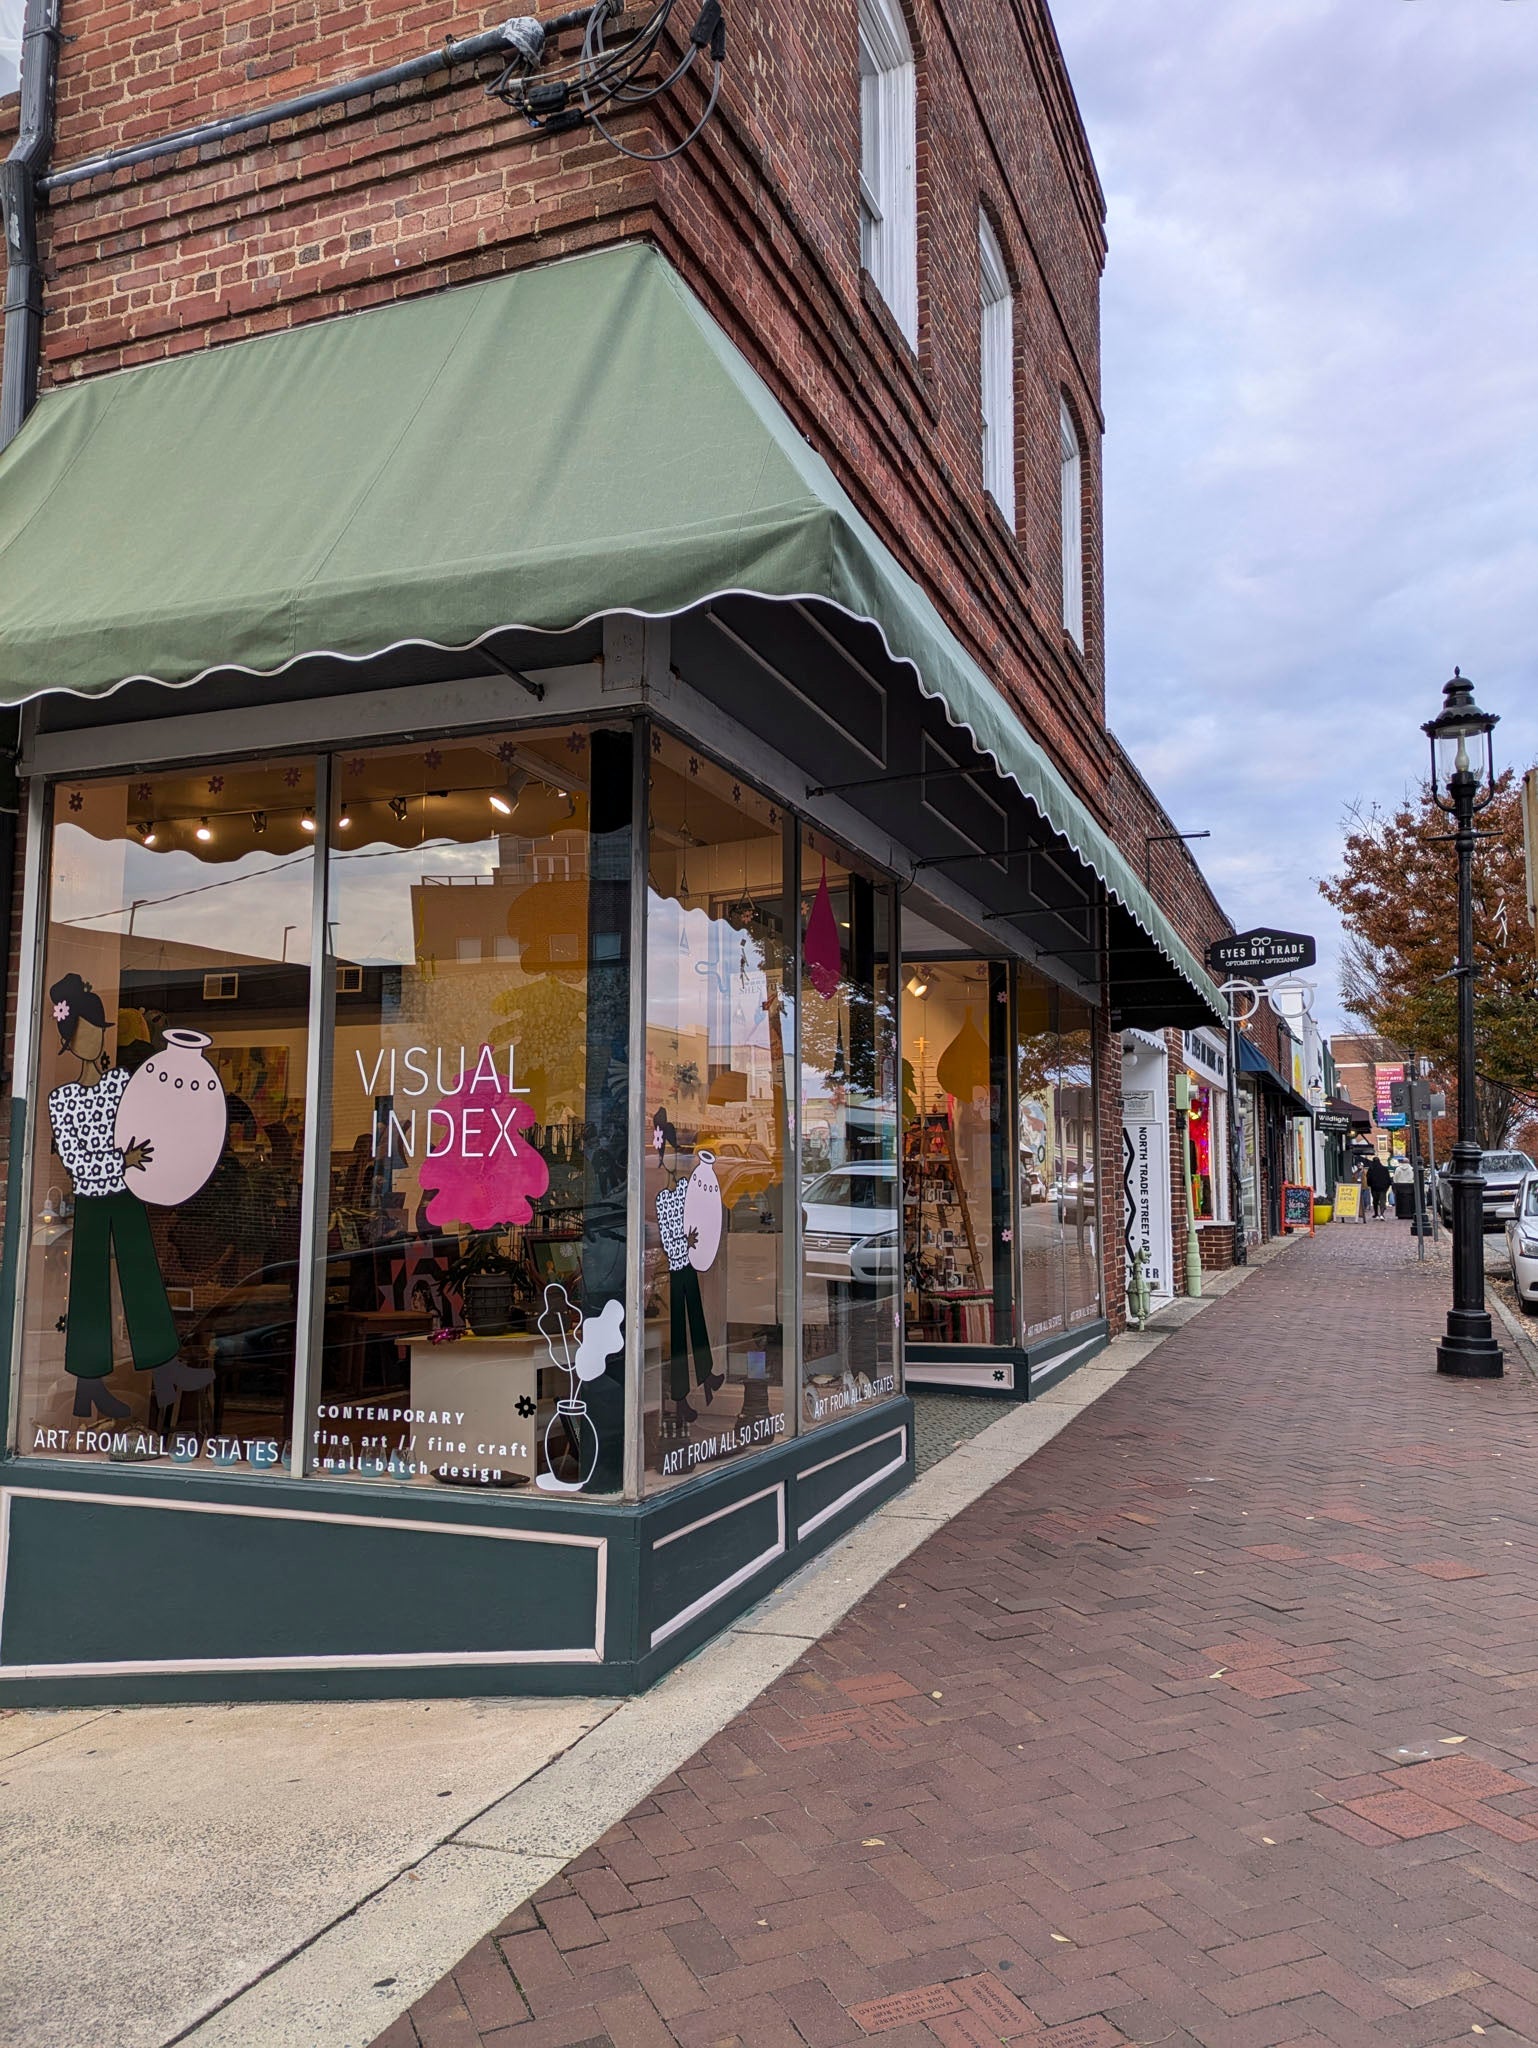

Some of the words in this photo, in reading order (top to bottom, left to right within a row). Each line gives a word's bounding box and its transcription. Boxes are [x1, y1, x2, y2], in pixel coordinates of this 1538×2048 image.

[1220, 948, 1246, 959] EYES
[1251, 946, 1265, 957] ON
[1270, 944, 1305, 956] TRADE
[1225, 959, 1261, 967] OPTOMETRY
[356, 1045, 531, 1096] VISUAL
[371, 1107, 518, 1158] INDEX
[1318, 1115, 1349, 1123] Wildlight
[1139, 1126, 1148, 1160] NORTH
[1140, 1163, 1149, 1195] TRADE
[1141, 1198, 1150, 1236] STREET
[814, 1397, 829, 1419] ART
[830, 1391, 850, 1413] FROM
[849, 1386, 863, 1406] ALL
[863, 1384, 872, 1400] 50
[872, 1375, 894, 1396] STATES
[317, 1405, 465, 1425] CONTEMPORARY
[33, 1429, 70, 1450] ART
[76, 1431, 127, 1453] FROM
[134, 1434, 169, 1456] ALL
[175, 1437, 199, 1458] 50
[205, 1438, 279, 1463] STATES
[313, 1430, 350, 1446] fine
[361, 1435, 388, 1448] art
[428, 1437, 467, 1453] fine
[477, 1442, 528, 1458] craft
[662, 1447, 685, 1476] ART
[687, 1437, 718, 1466] FROM
[719, 1431, 738, 1454] ALL
[740, 1425, 751, 1444] 50
[753, 1413, 786, 1441] STATES
[312, 1456, 428, 1475] small-batch
[439, 1462, 502, 1483] design
